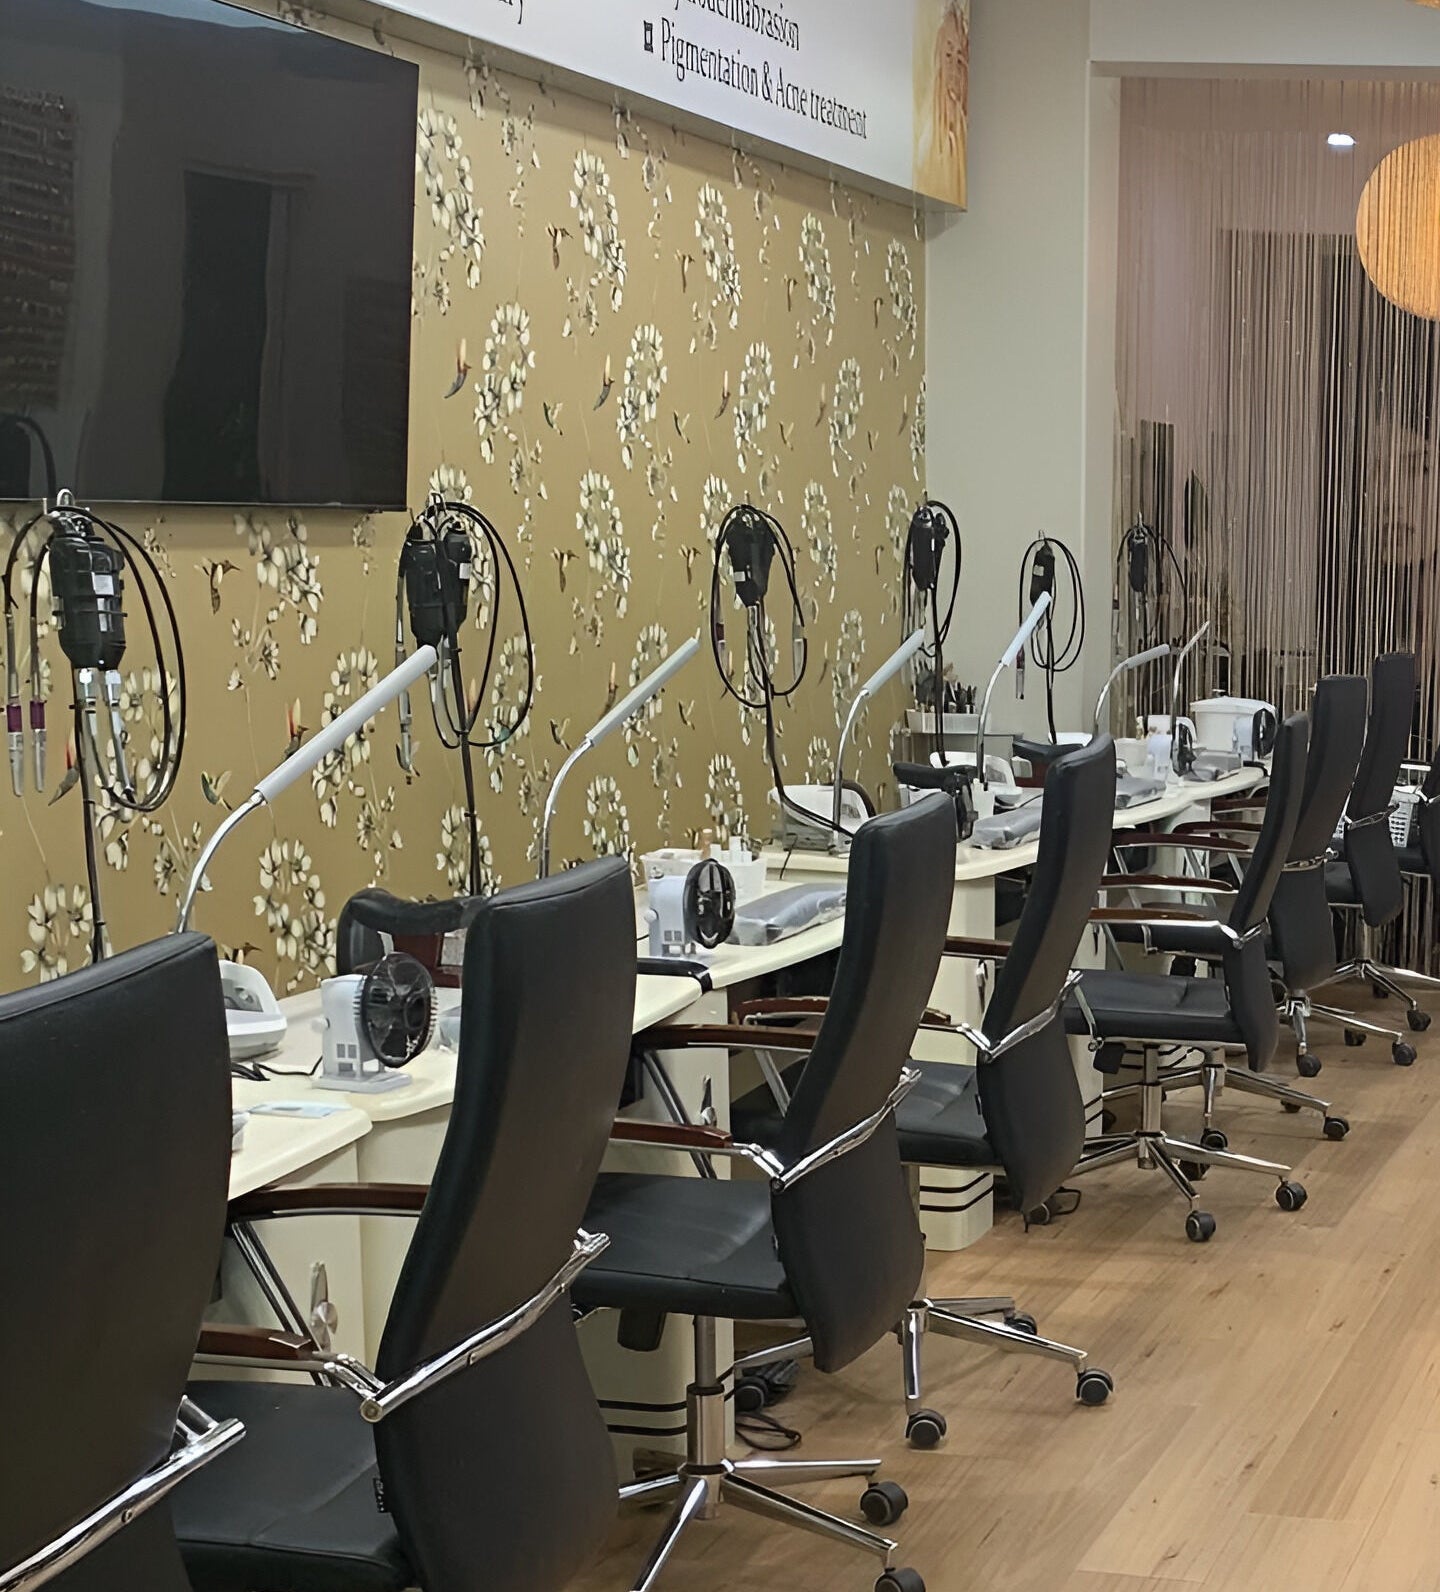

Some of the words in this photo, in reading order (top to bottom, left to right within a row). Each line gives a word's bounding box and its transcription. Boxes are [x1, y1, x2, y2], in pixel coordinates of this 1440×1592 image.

[661, 16, 759, 98] Pigmentation
[761, 60, 773, 104] &
[775, 66, 807, 117] Acne
[810, 88, 868, 140] treatment
